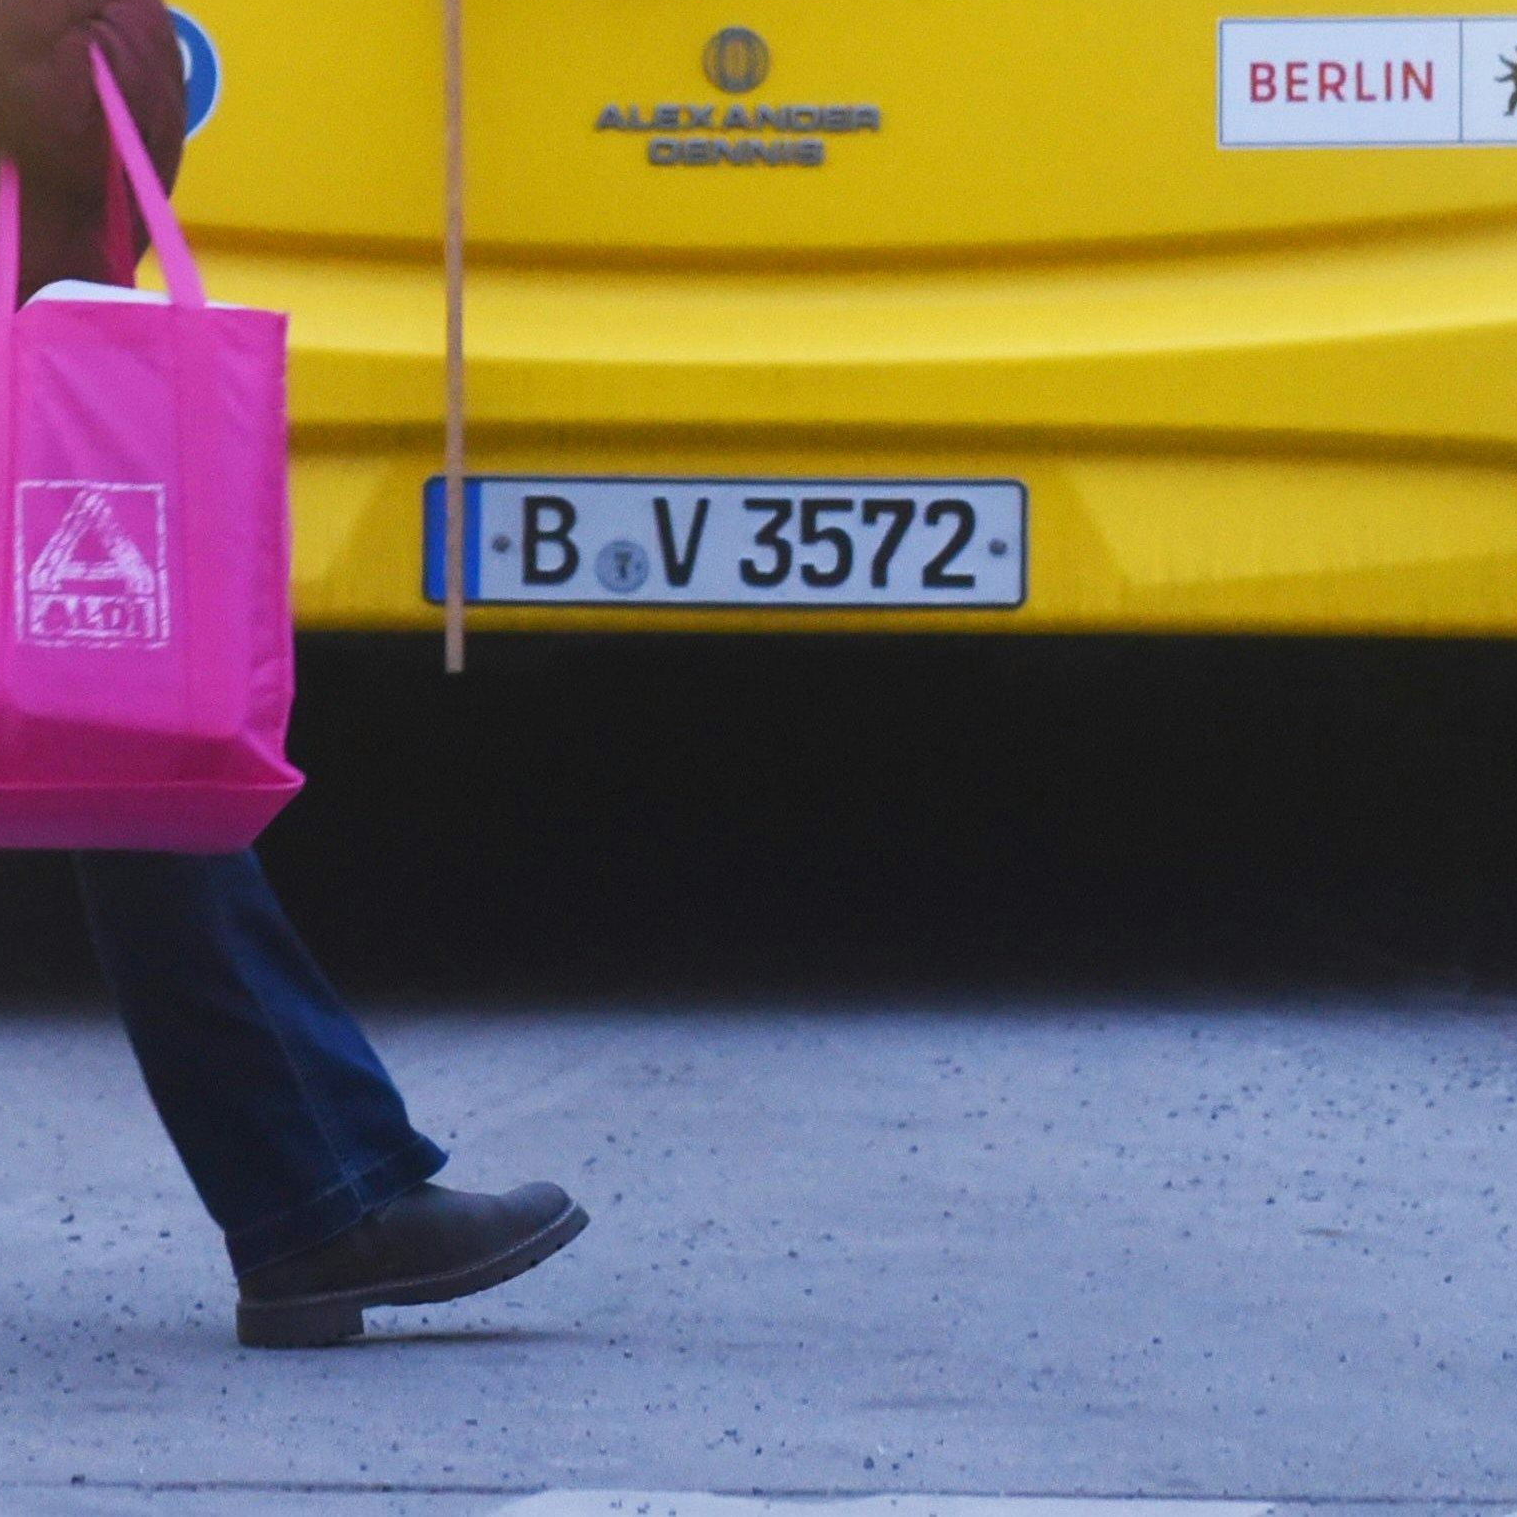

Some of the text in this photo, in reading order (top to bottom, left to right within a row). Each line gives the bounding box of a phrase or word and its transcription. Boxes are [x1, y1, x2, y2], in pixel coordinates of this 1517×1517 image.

[1248, 60, 1435, 103] BERLIN
[595, 102, 881, 132] ALEXANDER
[647, 136, 825, 167] DENNIS
[521, 494, 977, 590] B V 3572
